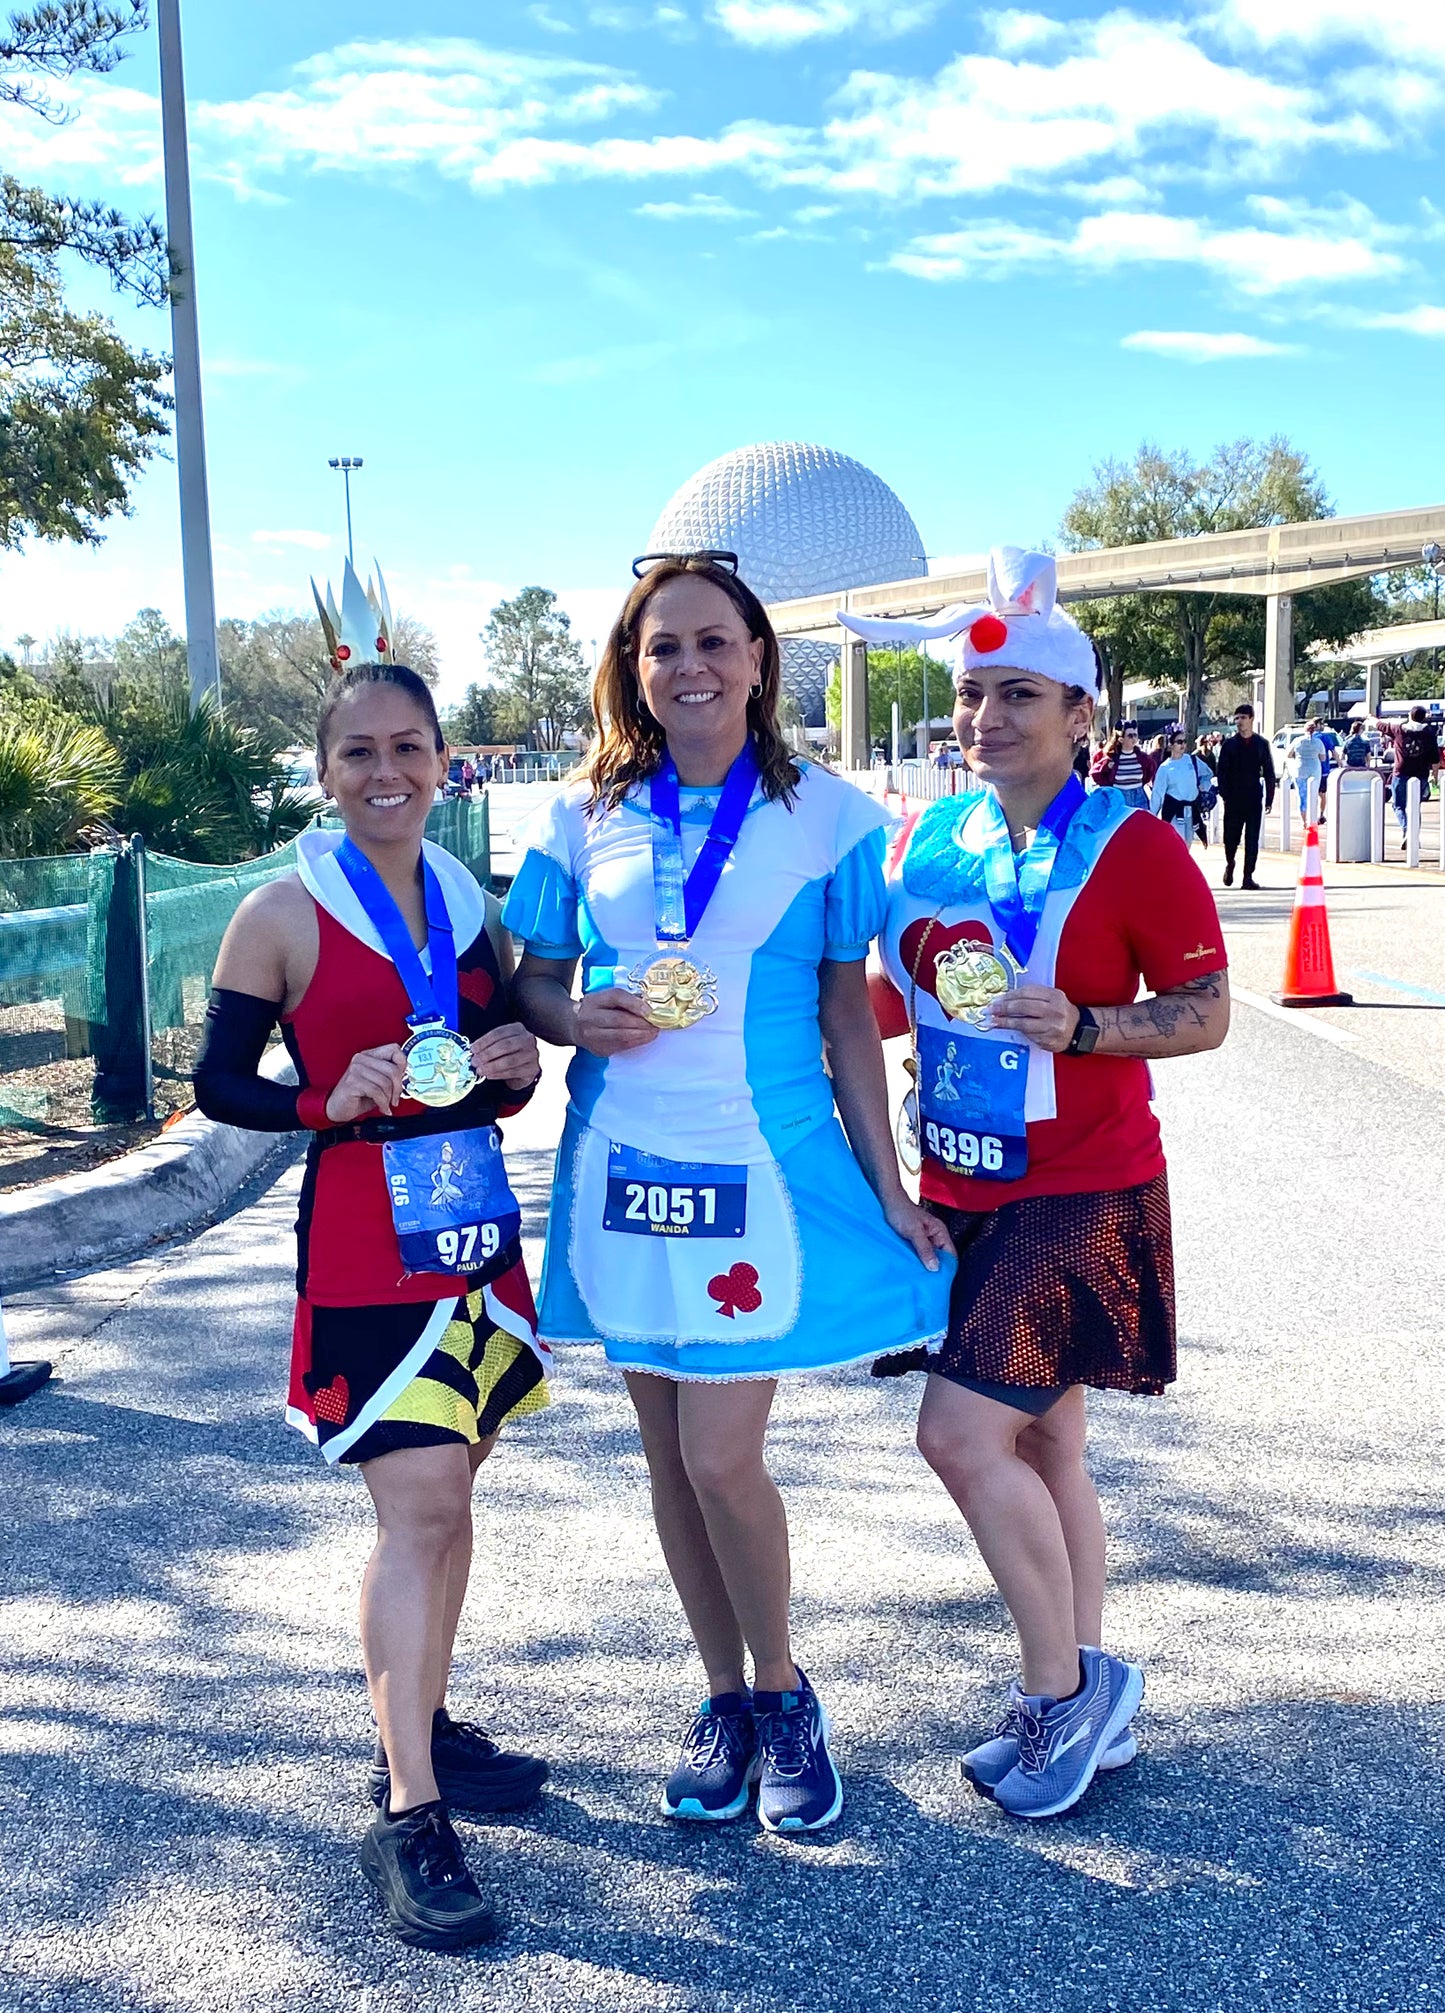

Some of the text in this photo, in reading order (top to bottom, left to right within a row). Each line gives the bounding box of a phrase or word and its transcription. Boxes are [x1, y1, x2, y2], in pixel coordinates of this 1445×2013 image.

[1000, 1050, 1019, 1070] G
[926, 1122, 1003, 1170] 9396
[391, 1174, 410, 1207] 979
[625, 1183, 716, 1225] 2051
[436, 1223, 500, 1266] 979
[650, 1223, 690, 1234] WANDA
